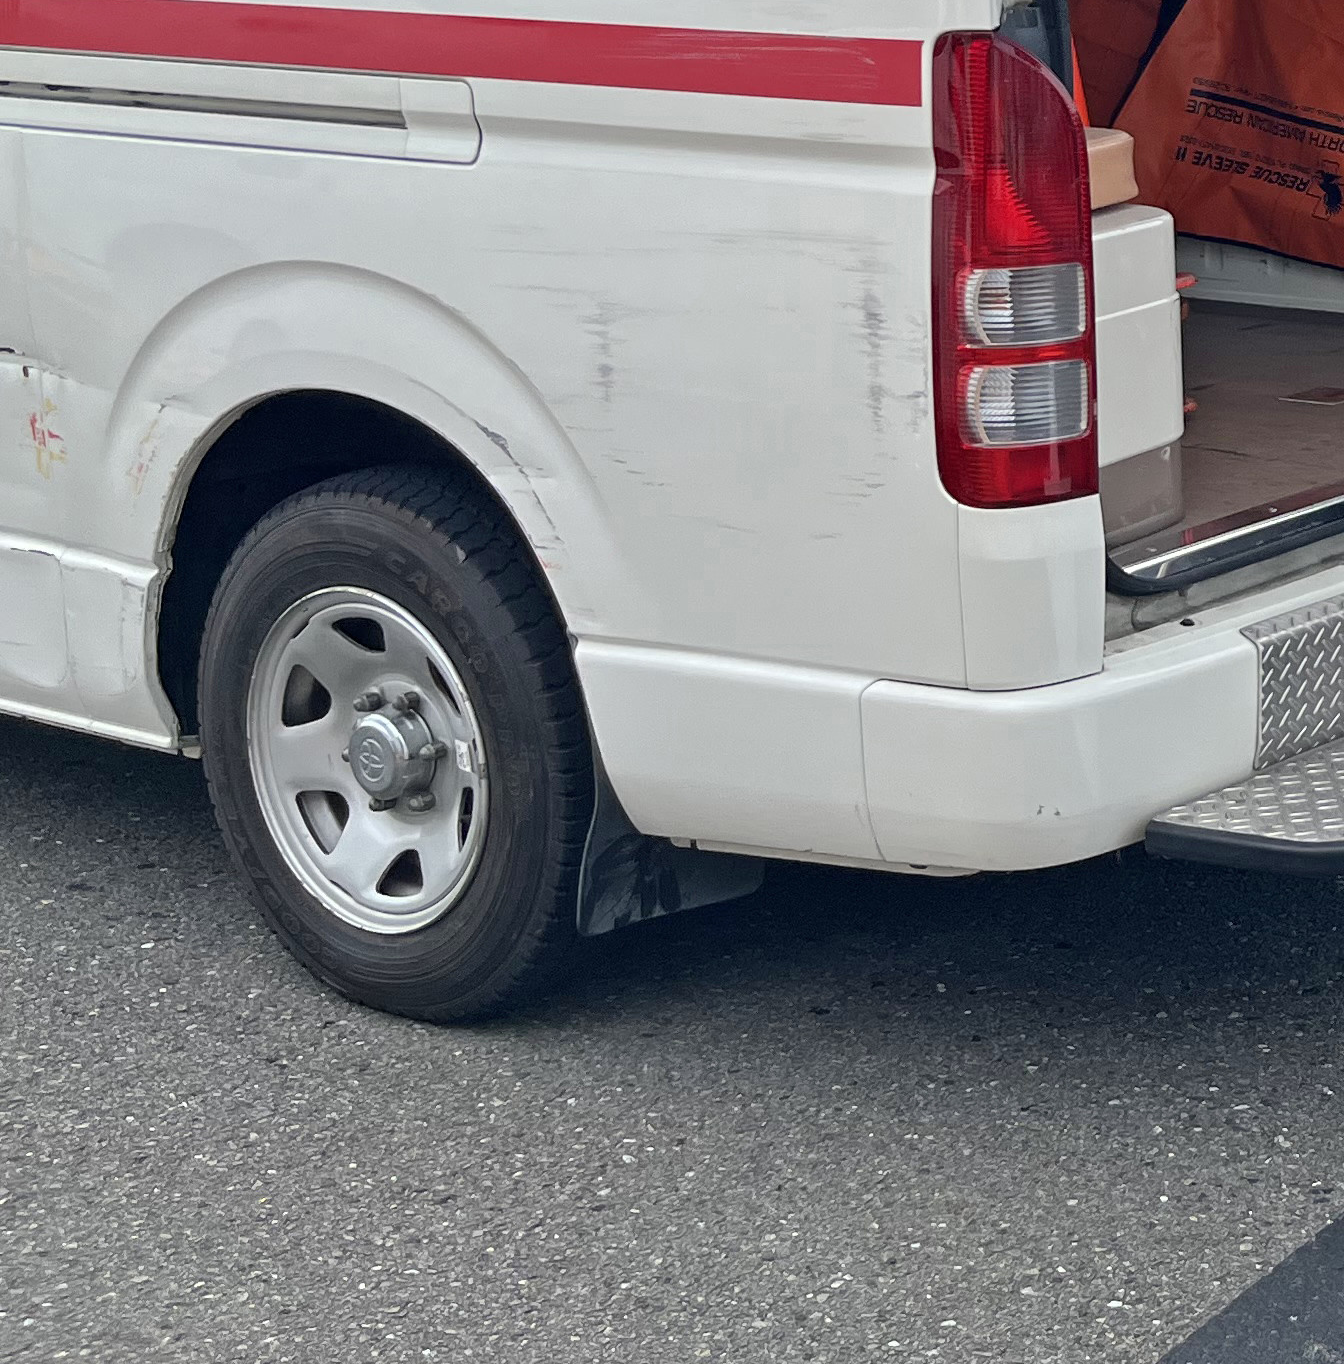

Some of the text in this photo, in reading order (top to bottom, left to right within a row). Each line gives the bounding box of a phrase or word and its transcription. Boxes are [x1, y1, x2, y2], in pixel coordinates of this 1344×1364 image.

[1184, 98, 1244, 125] RESCUE
[1191, 149, 1251, 175] SLEEVE
[1248, 165, 1311, 192] RESCUE
